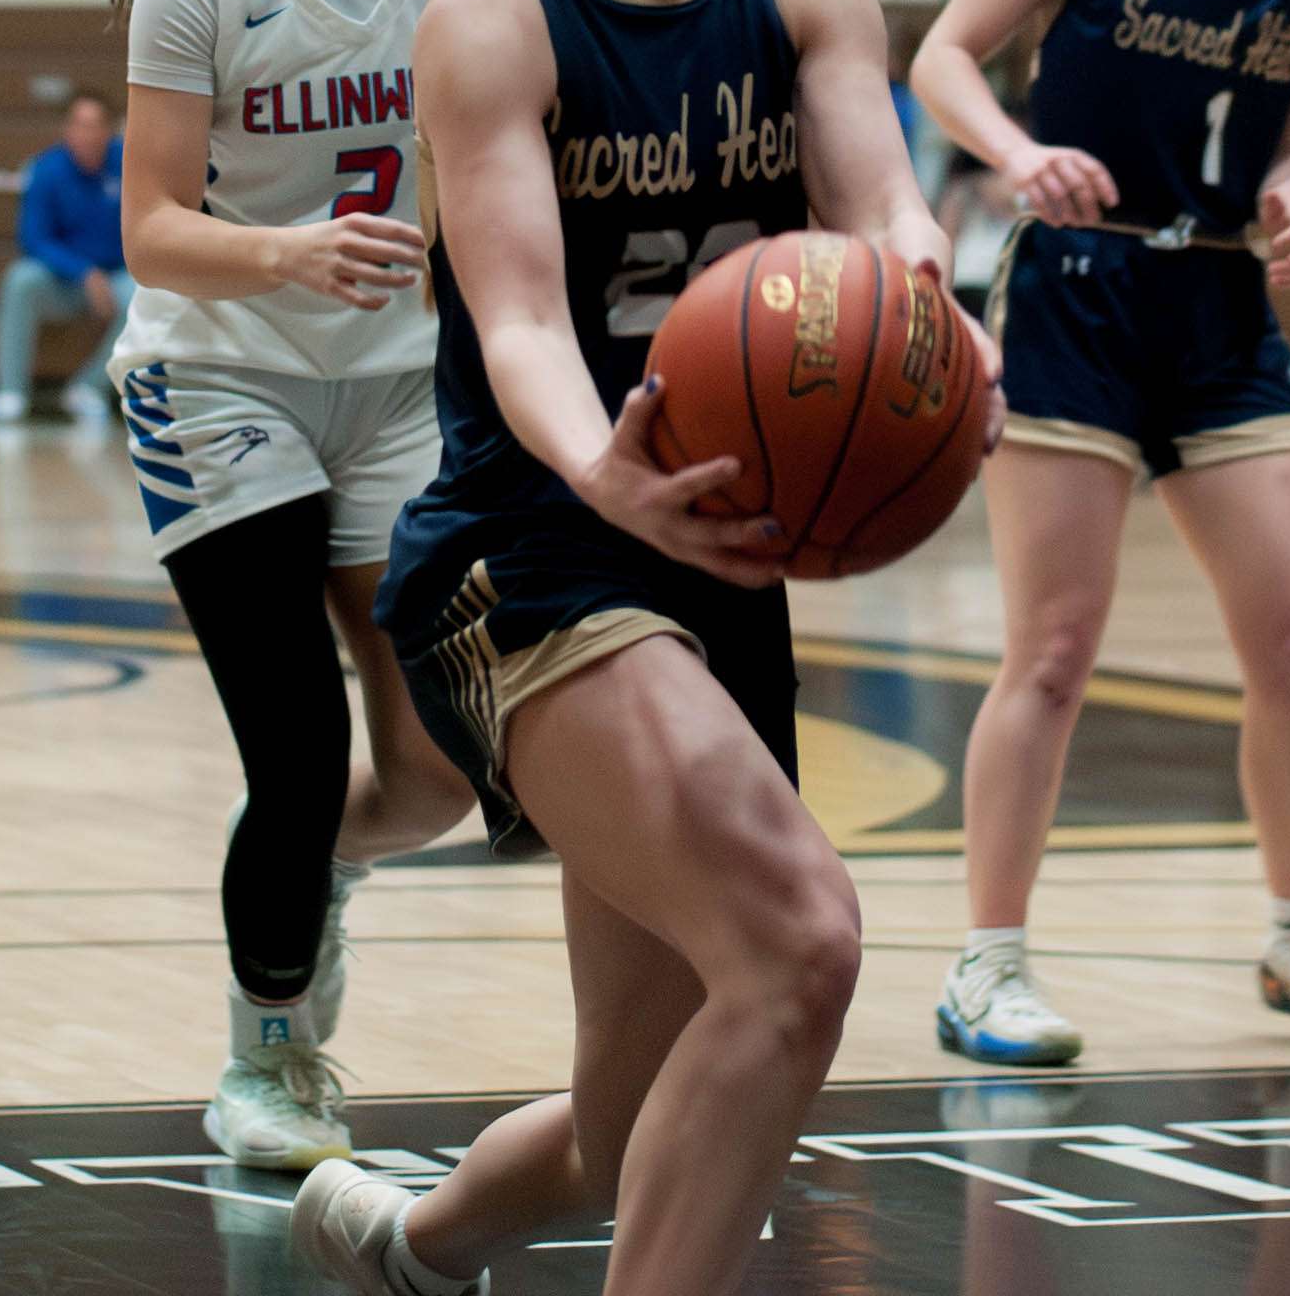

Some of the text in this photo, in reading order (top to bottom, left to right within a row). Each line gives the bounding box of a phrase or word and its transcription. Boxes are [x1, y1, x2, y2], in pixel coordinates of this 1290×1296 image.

[242, 67, 415, 135] ELLINW
[550, 72, 797, 200] acred Hea
[1201, 90, 1234, 186] 1
[329, 144, 404, 221] 2
